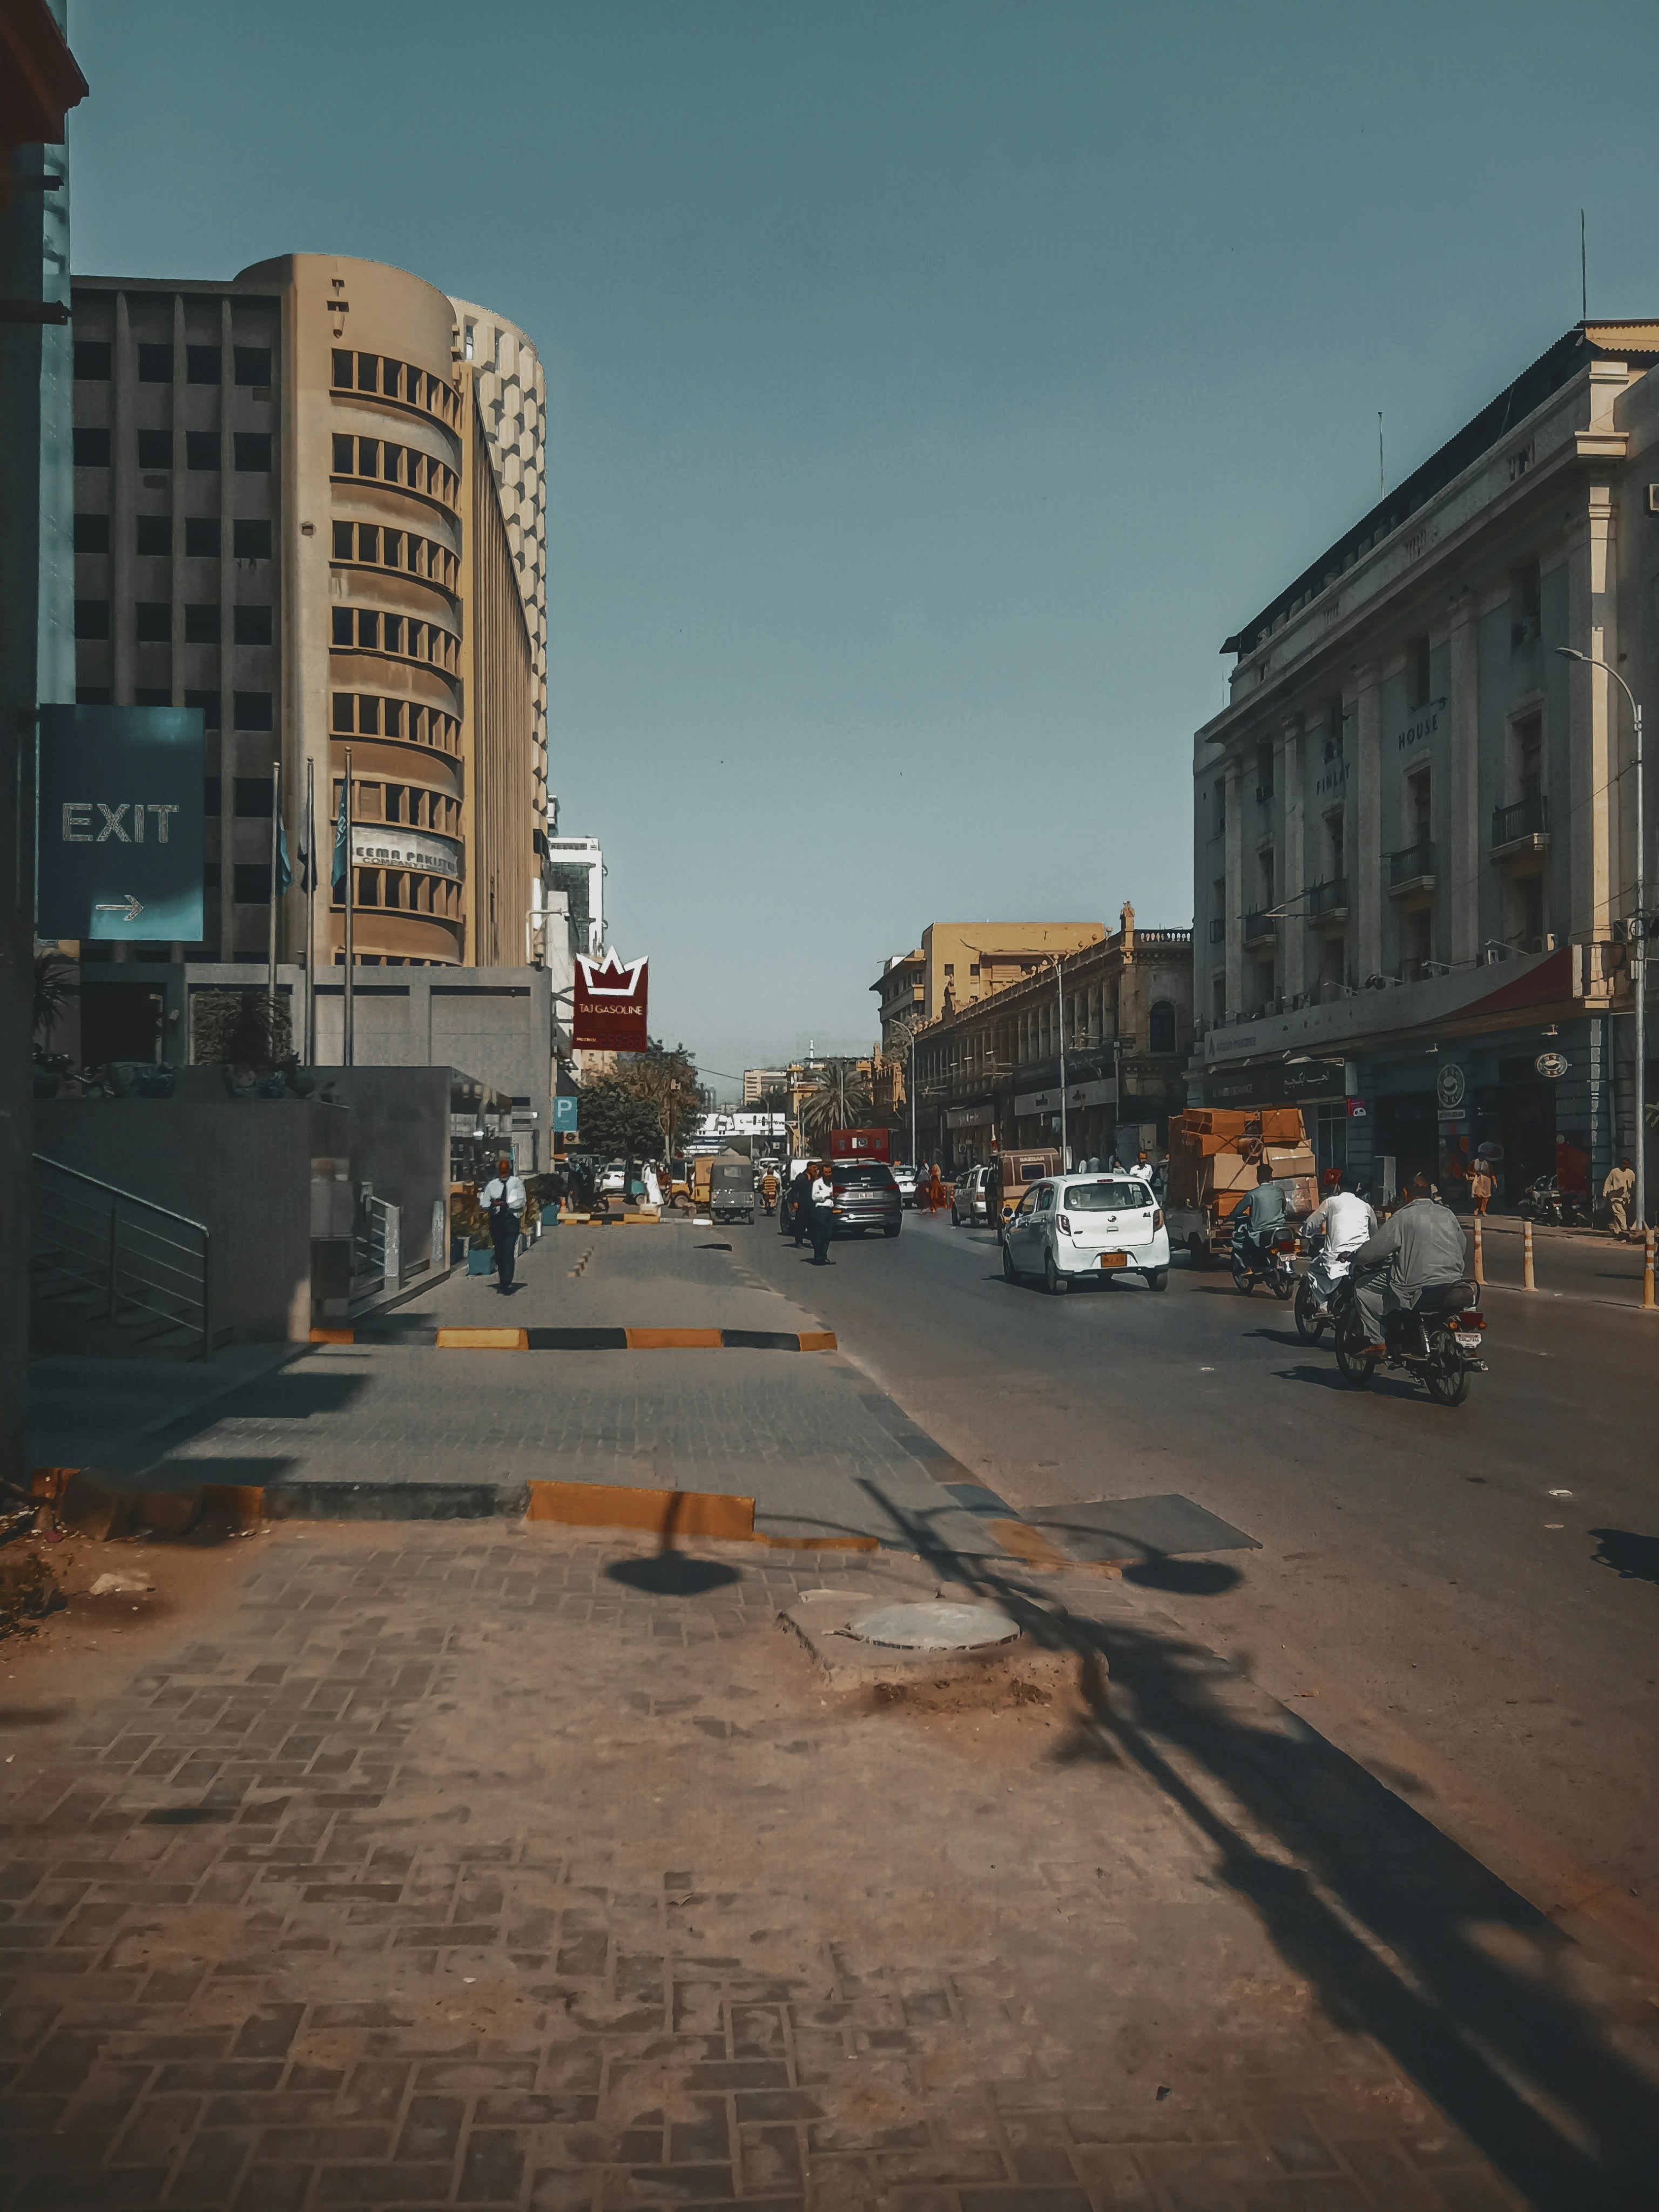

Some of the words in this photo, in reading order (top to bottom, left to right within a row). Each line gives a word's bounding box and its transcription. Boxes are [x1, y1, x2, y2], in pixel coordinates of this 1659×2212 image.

[1398, 714, 1438, 750] HOUSE
[1317, 763, 1351, 797] FINLAY
[63, 803, 179, 843] EXIT
[579, 1003, 593, 1013] TAJ
[595, 1004, 643, 1015] GASOLINE
[557, 1099, 572, 1118] P
